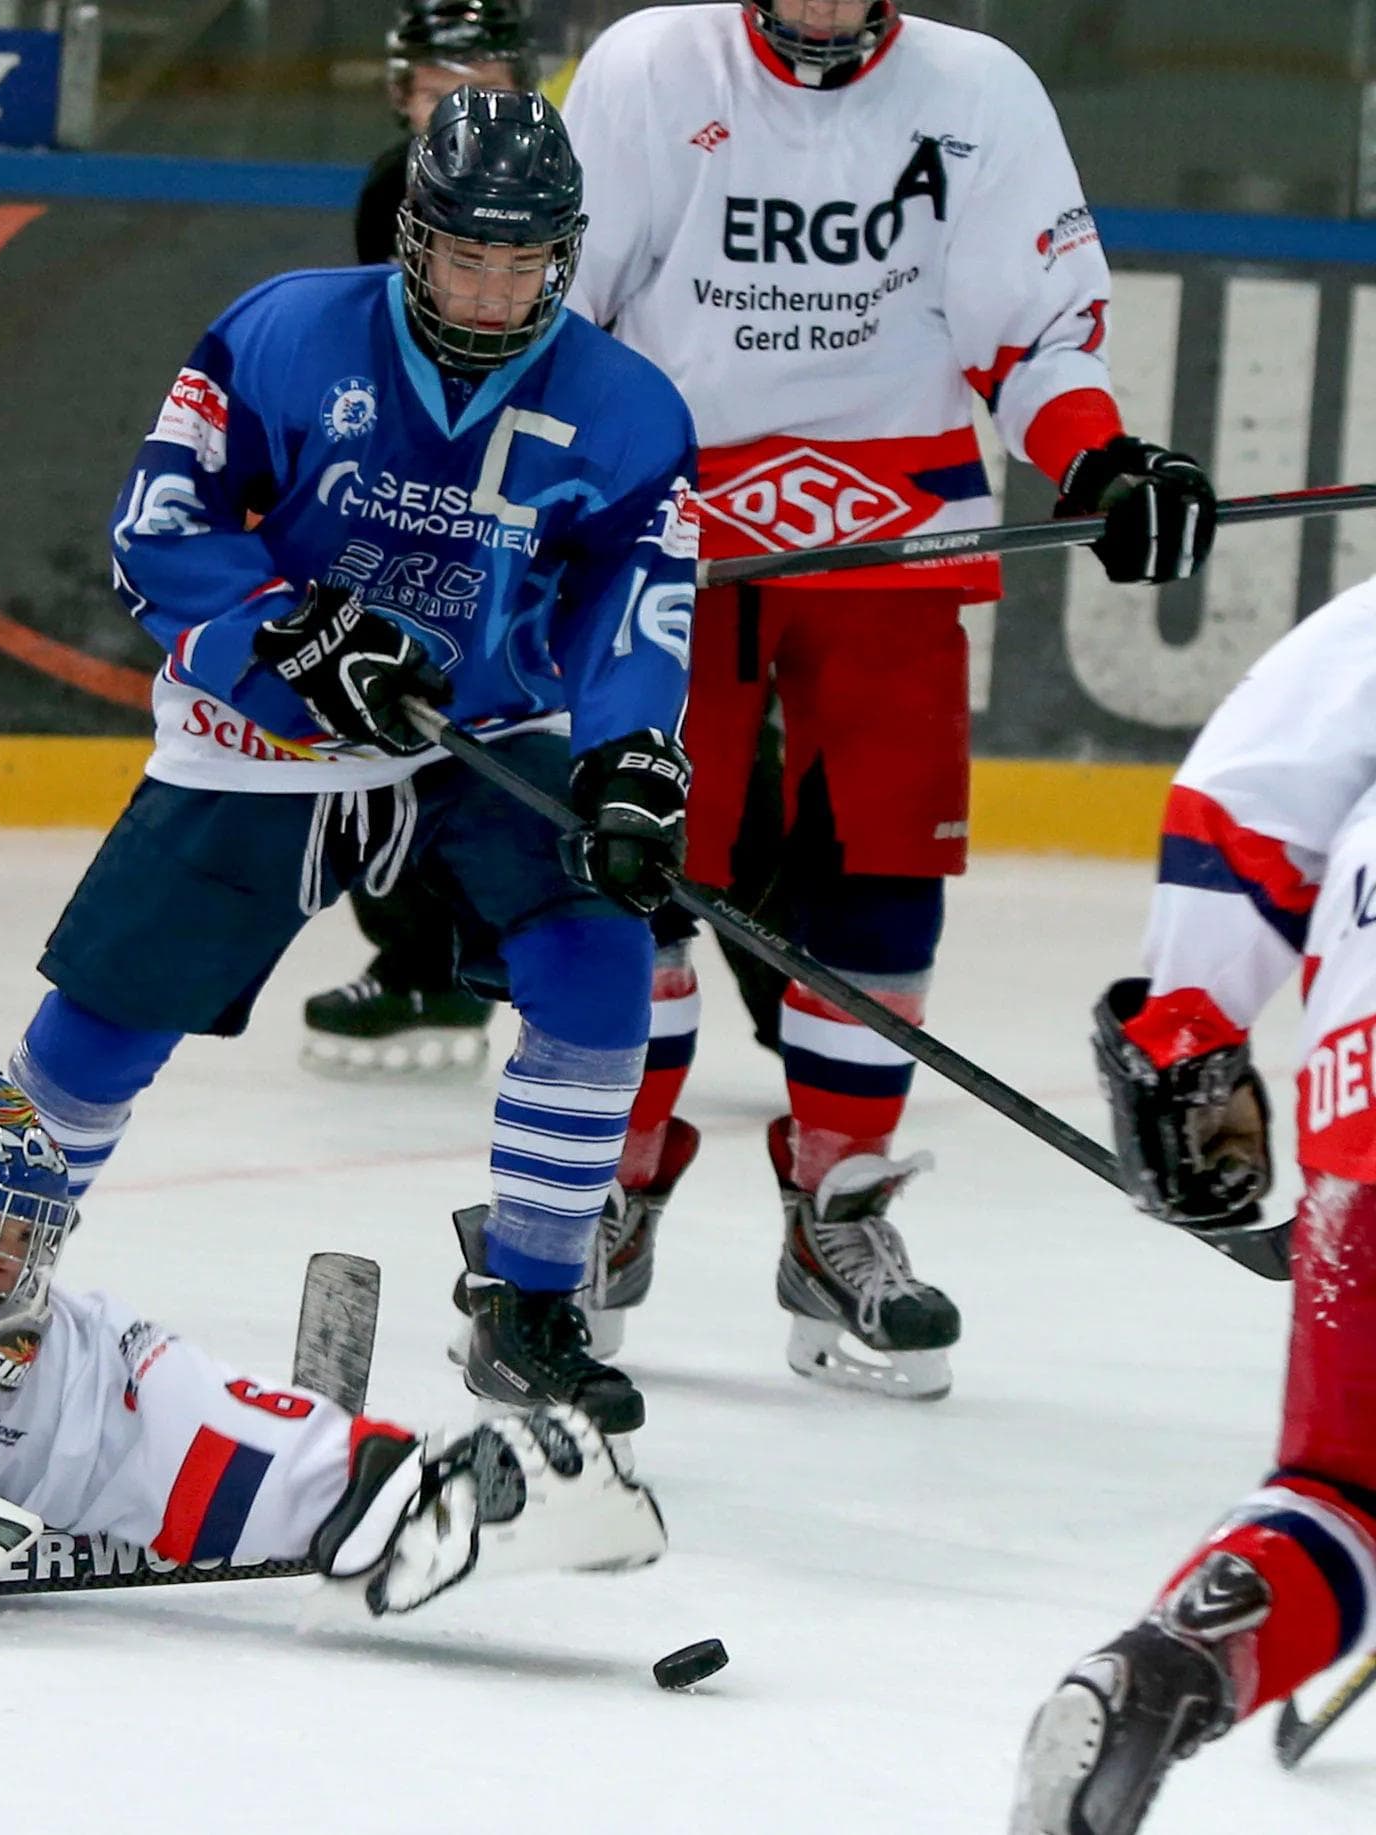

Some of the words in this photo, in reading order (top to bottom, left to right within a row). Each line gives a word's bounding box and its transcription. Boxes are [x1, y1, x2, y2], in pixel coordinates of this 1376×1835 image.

[723, 196, 903, 265] ERGO
[693, 265, 920, 317] Versicherungsüro
[735, 325, 800, 350] Gerd
[471, 404, 577, 530] C
[360, 499, 541, 559] IMMOBILIEN
[611, 566, 697, 672] 16
[1307, 1018, 1376, 1135] DE
